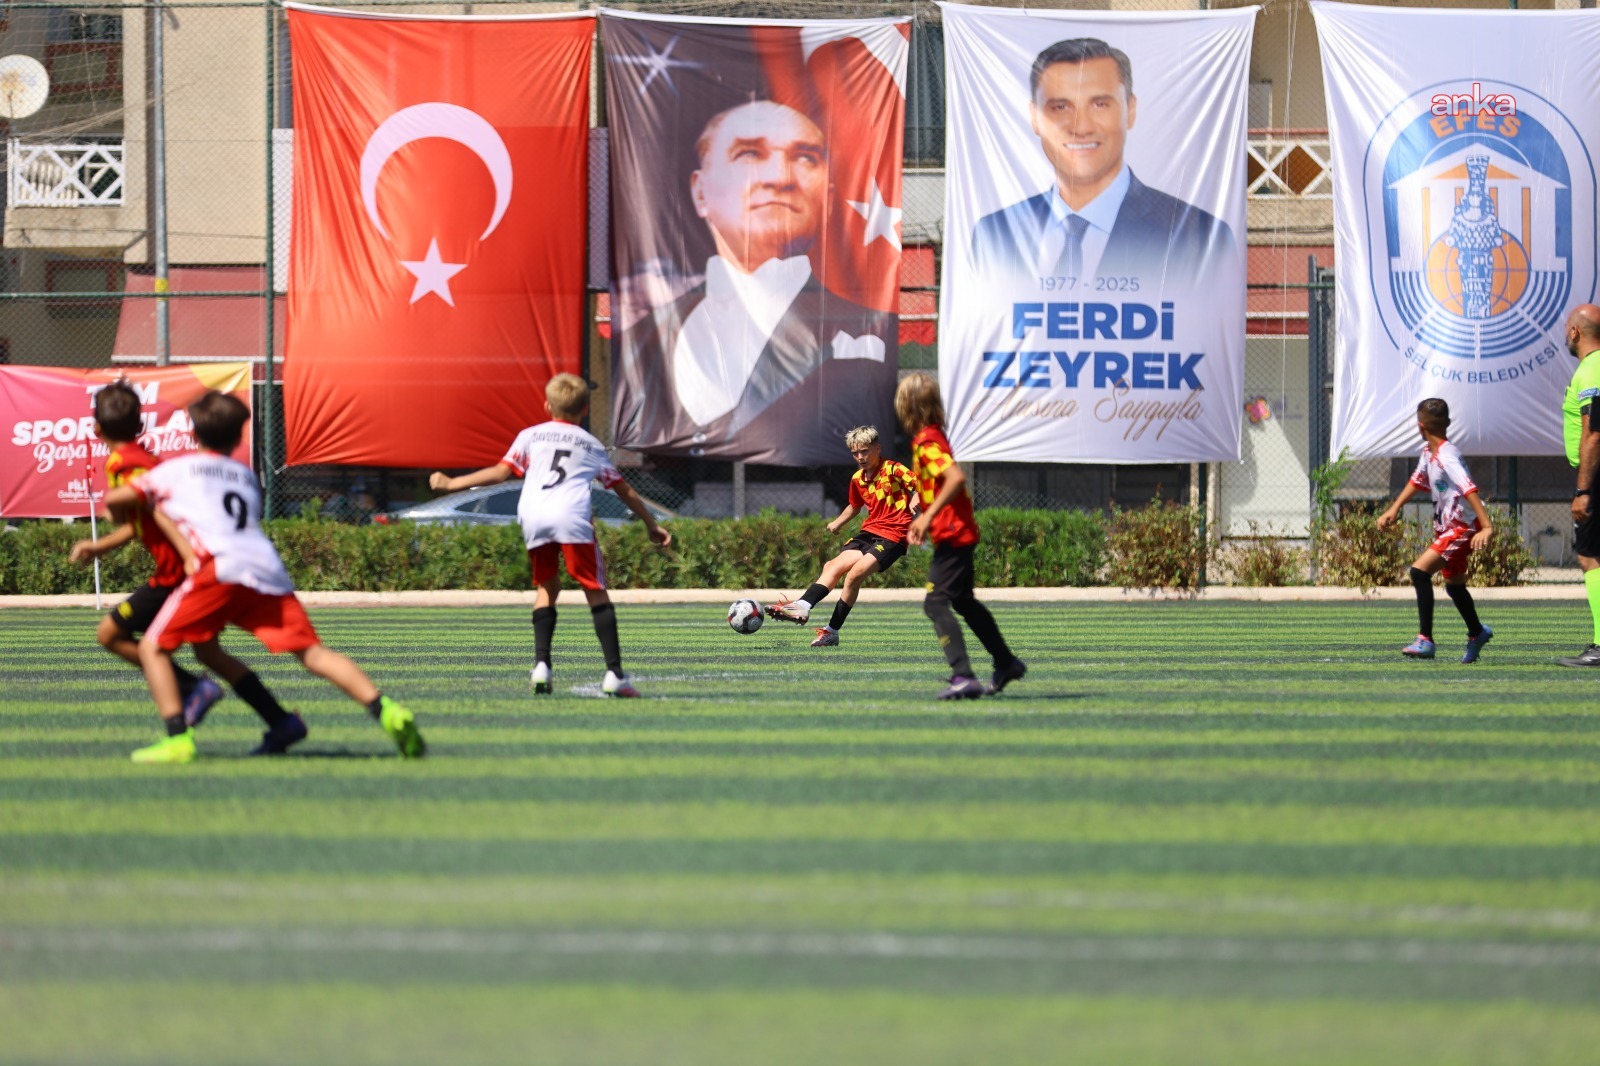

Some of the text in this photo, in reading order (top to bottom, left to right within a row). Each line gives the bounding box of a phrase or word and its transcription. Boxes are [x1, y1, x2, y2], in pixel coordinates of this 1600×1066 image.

[1429, 108, 1522, 139] EFES
[1039, 276, 1077, 292] 1977
[1096, 277, 1140, 292] 2025
[983, 351, 1205, 391] ZEYREK
[1404, 346, 1462, 382] SELÇUK
[86, 380, 160, 409] TM
[541, 448, 572, 490] 5
[223, 491, 248, 532] 9
